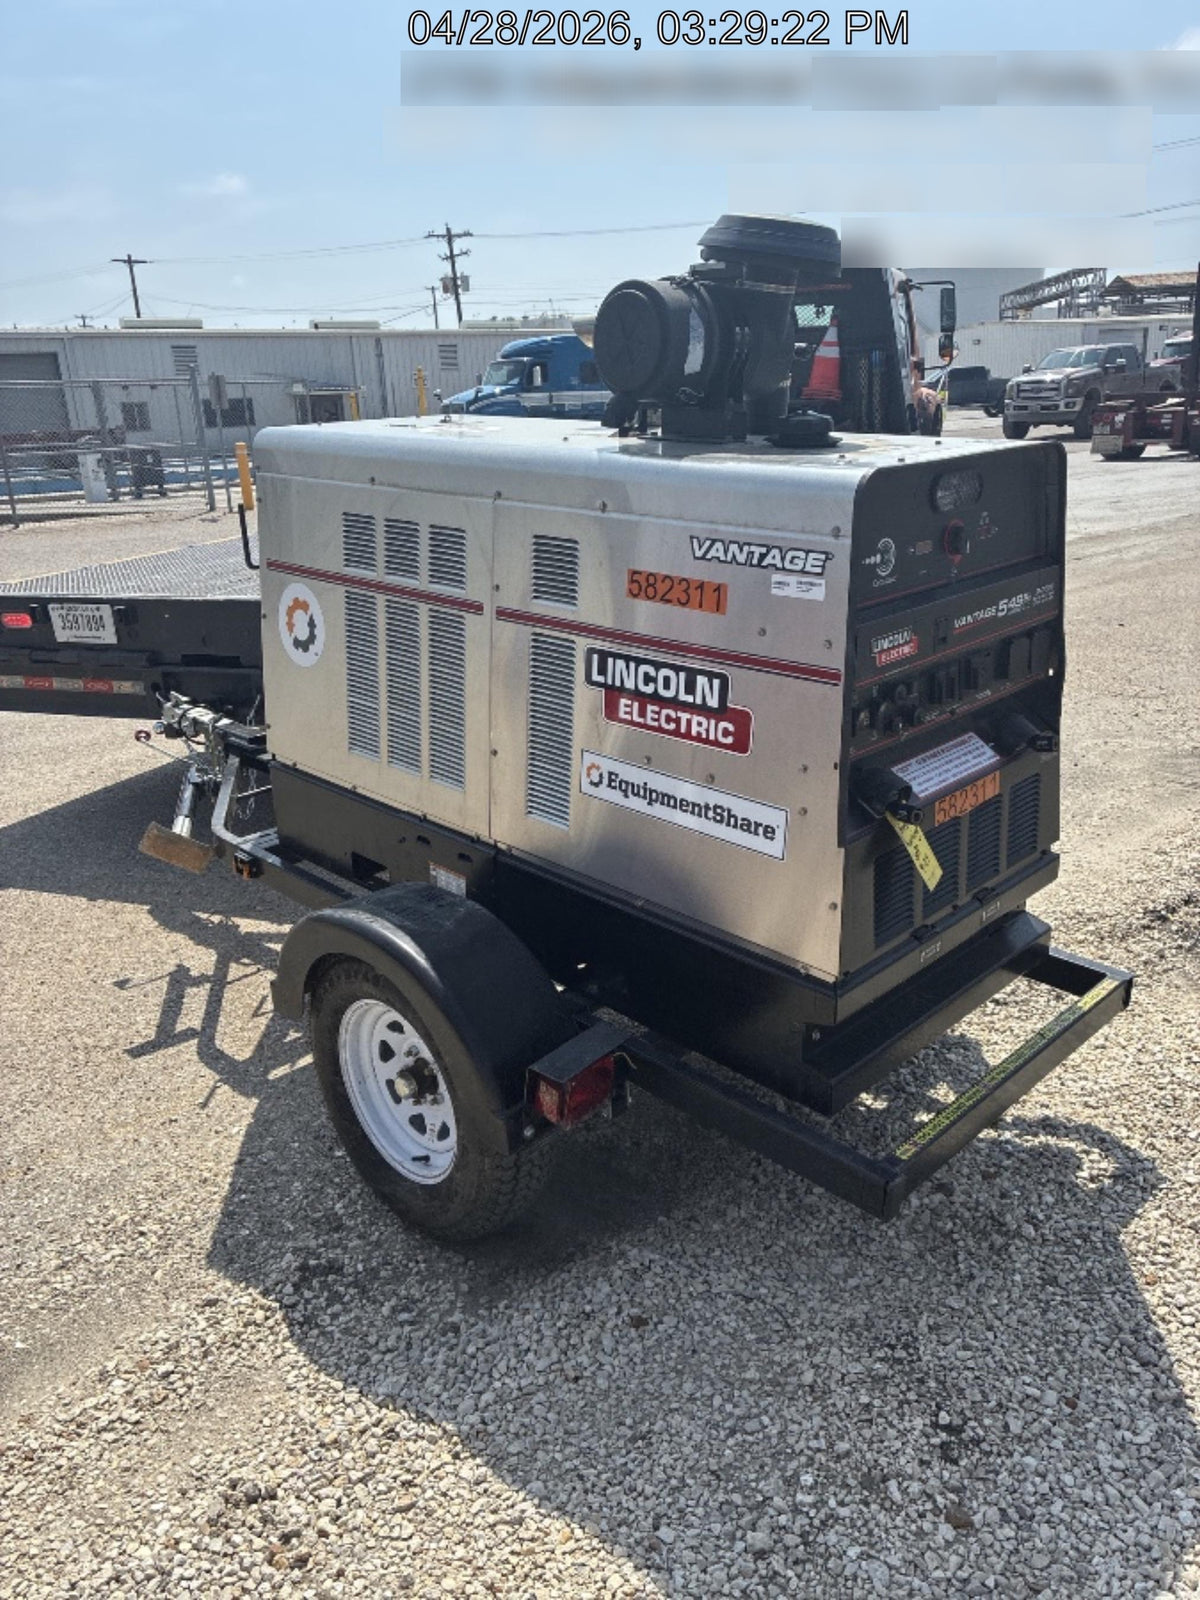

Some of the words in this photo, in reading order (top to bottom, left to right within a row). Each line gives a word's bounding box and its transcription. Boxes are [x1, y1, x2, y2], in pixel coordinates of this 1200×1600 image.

[690, 536, 830, 575] VANTAGE
[627, 570, 724, 613] 582311
[953, 605, 997, 628] VANTAGE
[873, 629, 912, 653] LINCOLN
[881, 642, 914, 662] ELECTRIC
[590, 653, 721, 709] LINCOLN
[617, 698, 735, 745] ELECTRIC
[605, 770, 777, 842] EquipmentShare
[937, 774, 998, 822] 582311
